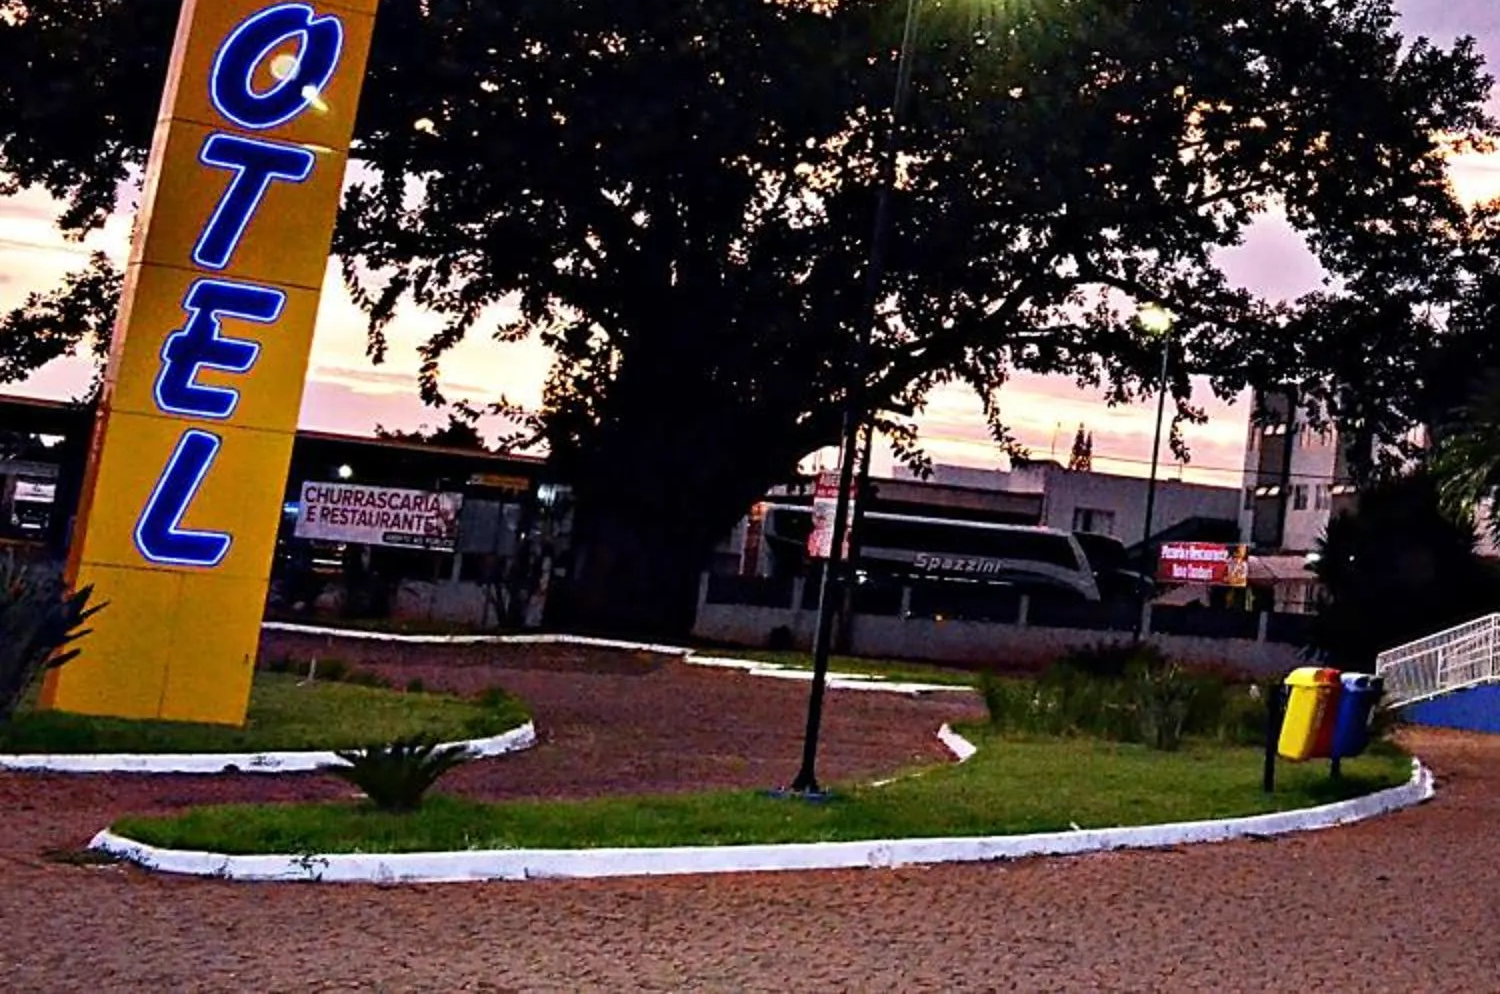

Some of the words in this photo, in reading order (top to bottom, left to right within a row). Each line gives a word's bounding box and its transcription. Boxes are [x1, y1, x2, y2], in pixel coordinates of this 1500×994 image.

[304, 485, 442, 513] CHURRASCARIA
[306, 505, 316, 523] E
[319, 506, 436, 534] RESTAURANTE
